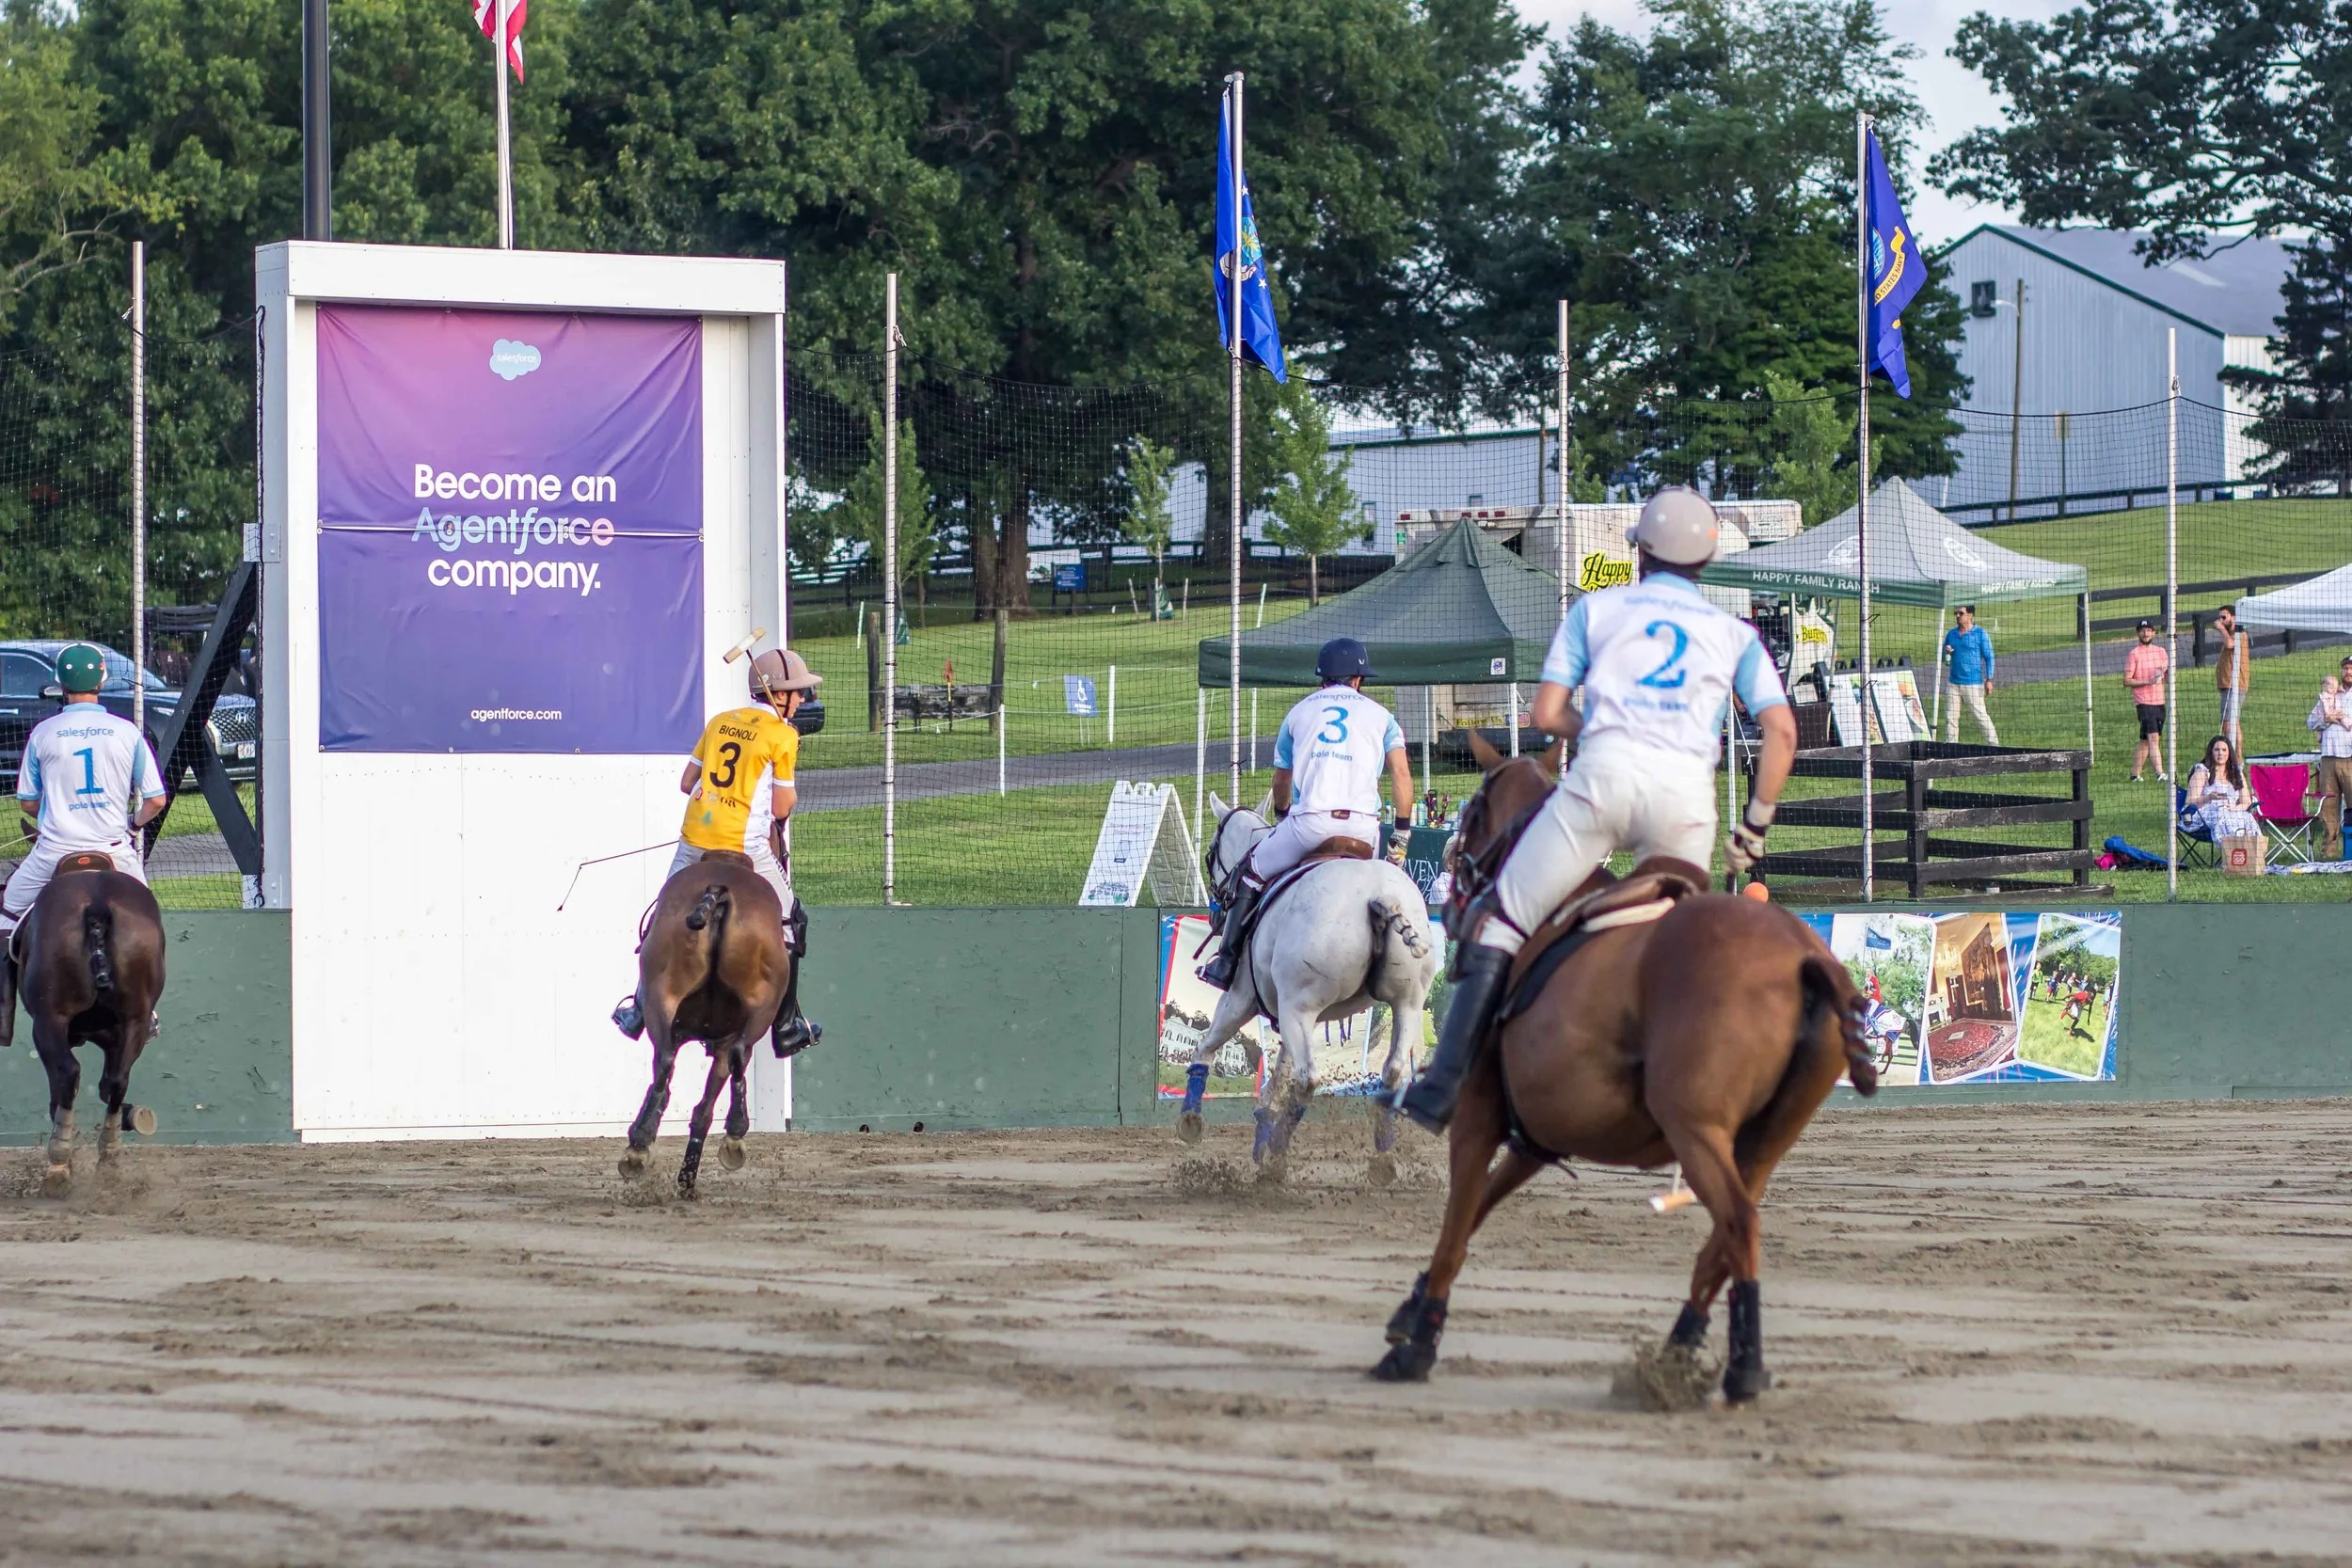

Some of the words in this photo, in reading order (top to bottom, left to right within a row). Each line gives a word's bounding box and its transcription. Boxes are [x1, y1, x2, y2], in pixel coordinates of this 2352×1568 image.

[1895, 254, 1903, 273] NAVY
[414, 464, 562, 501] Become
[571, 474, 616, 502] an
[411, 506, 614, 555] Agentforce
[428, 559, 601, 596] company.
[1581, 553, 1632, 586] Happy
[1753, 571, 1792, 583] HAPPY
[1794, 574, 1836, 588] FAMILY
[1837, 578, 1881, 594] RANH
[1635, 620, 1688, 689] 2
[470, 708, 563, 722] agentforce.com
[1317, 705, 1349, 744] 3
[56, 727, 115, 739] salesforce
[719, 724, 758, 742] BIGNOLI
[72, 747, 104, 795] 1
[709, 741, 742, 788] 3
[1331, 752, 1353, 761] team
[69, 801, 89, 812] polo
